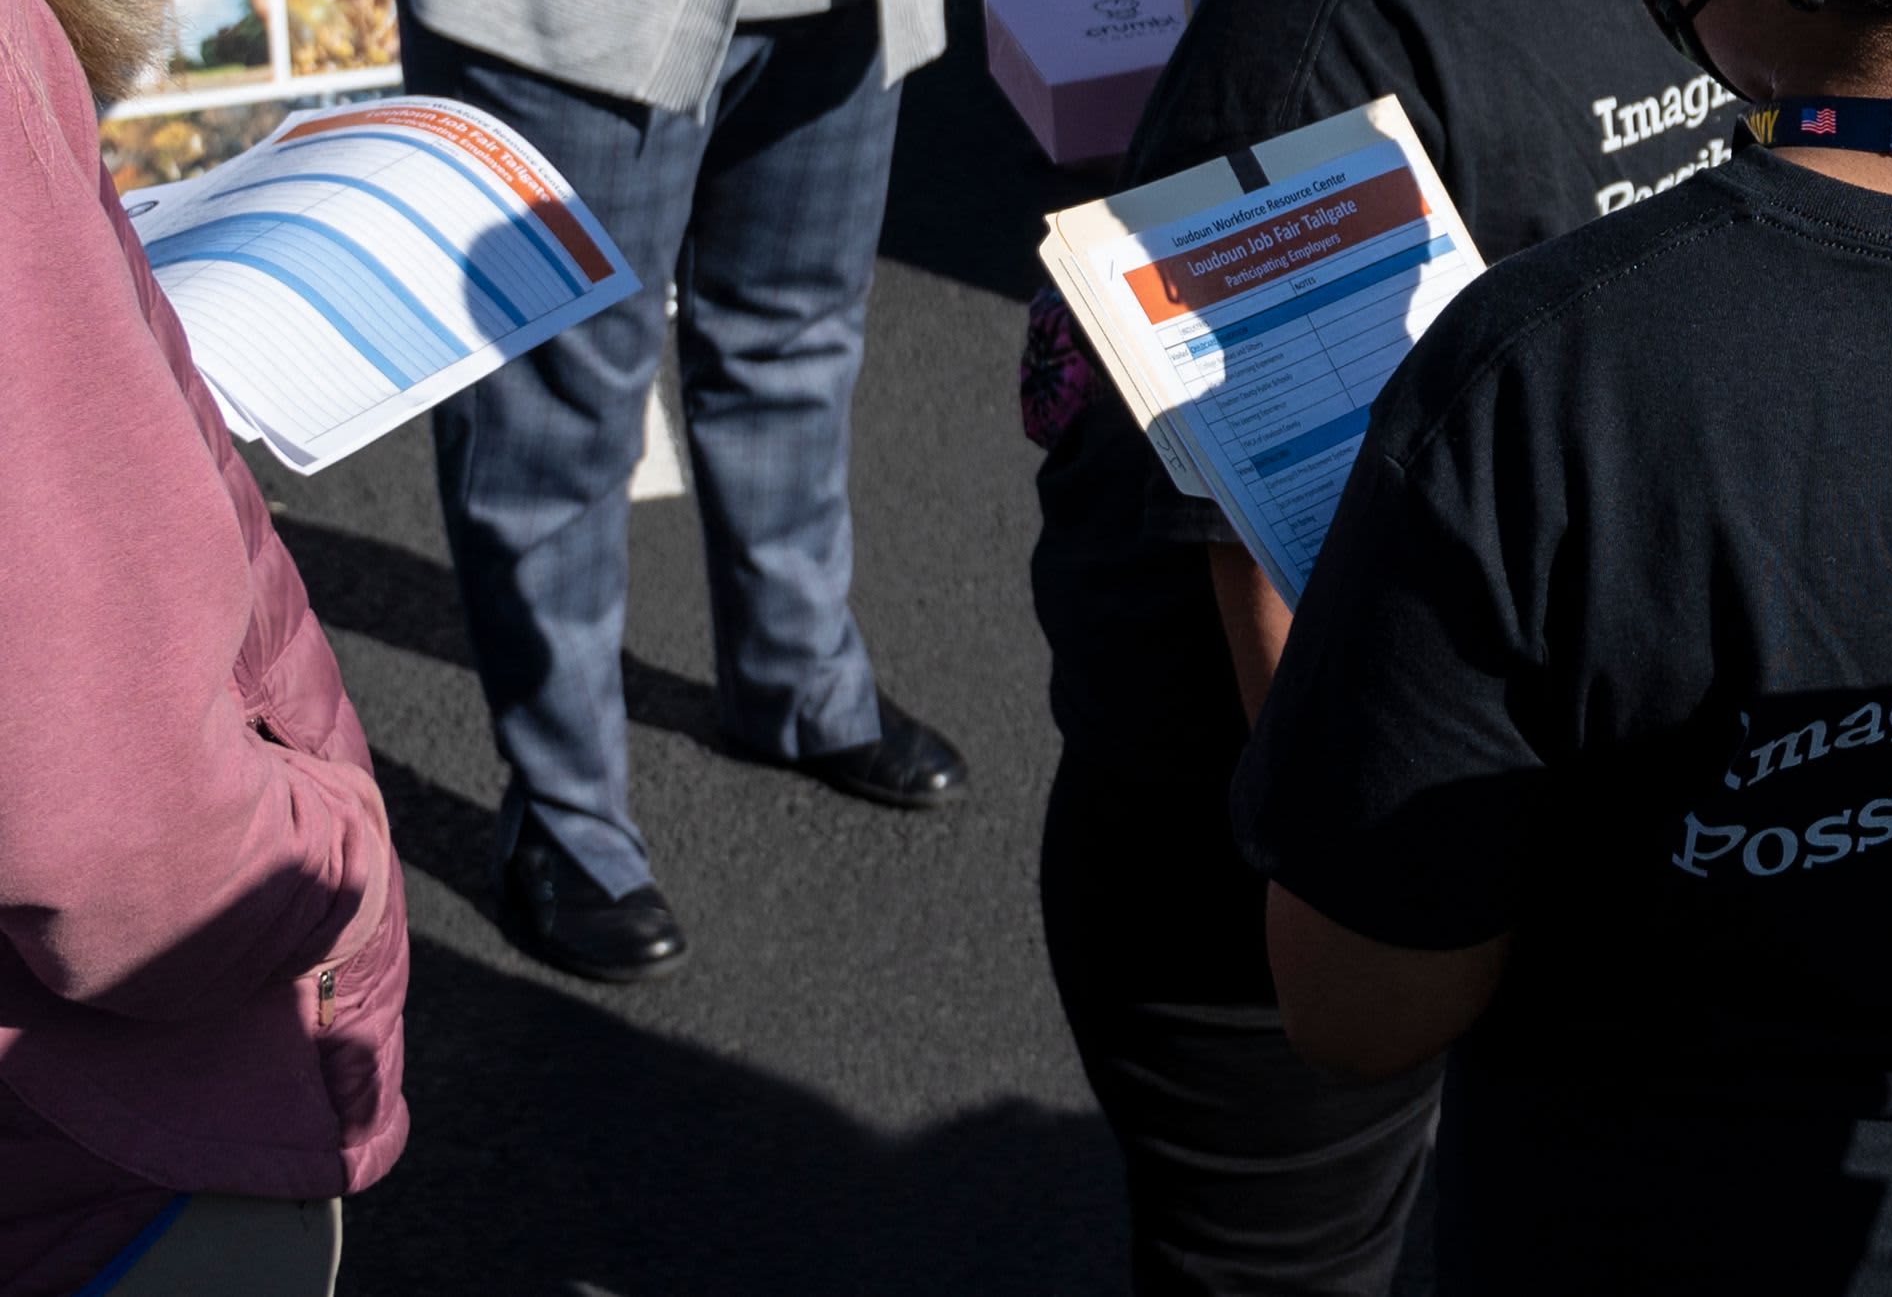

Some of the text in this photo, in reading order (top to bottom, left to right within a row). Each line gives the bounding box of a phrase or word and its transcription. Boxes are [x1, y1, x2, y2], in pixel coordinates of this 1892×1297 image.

[437, 117, 469, 133] Job
[469, 129, 501, 154] Fair
[500, 149, 552, 203] Tailgate
[1171, 172, 1347, 248] Loudoun Workforce Resource Center
[1187, 200, 1358, 277] Loudoun Job Fair Tailgate
[1225, 233, 1342, 288] Participating Employers
